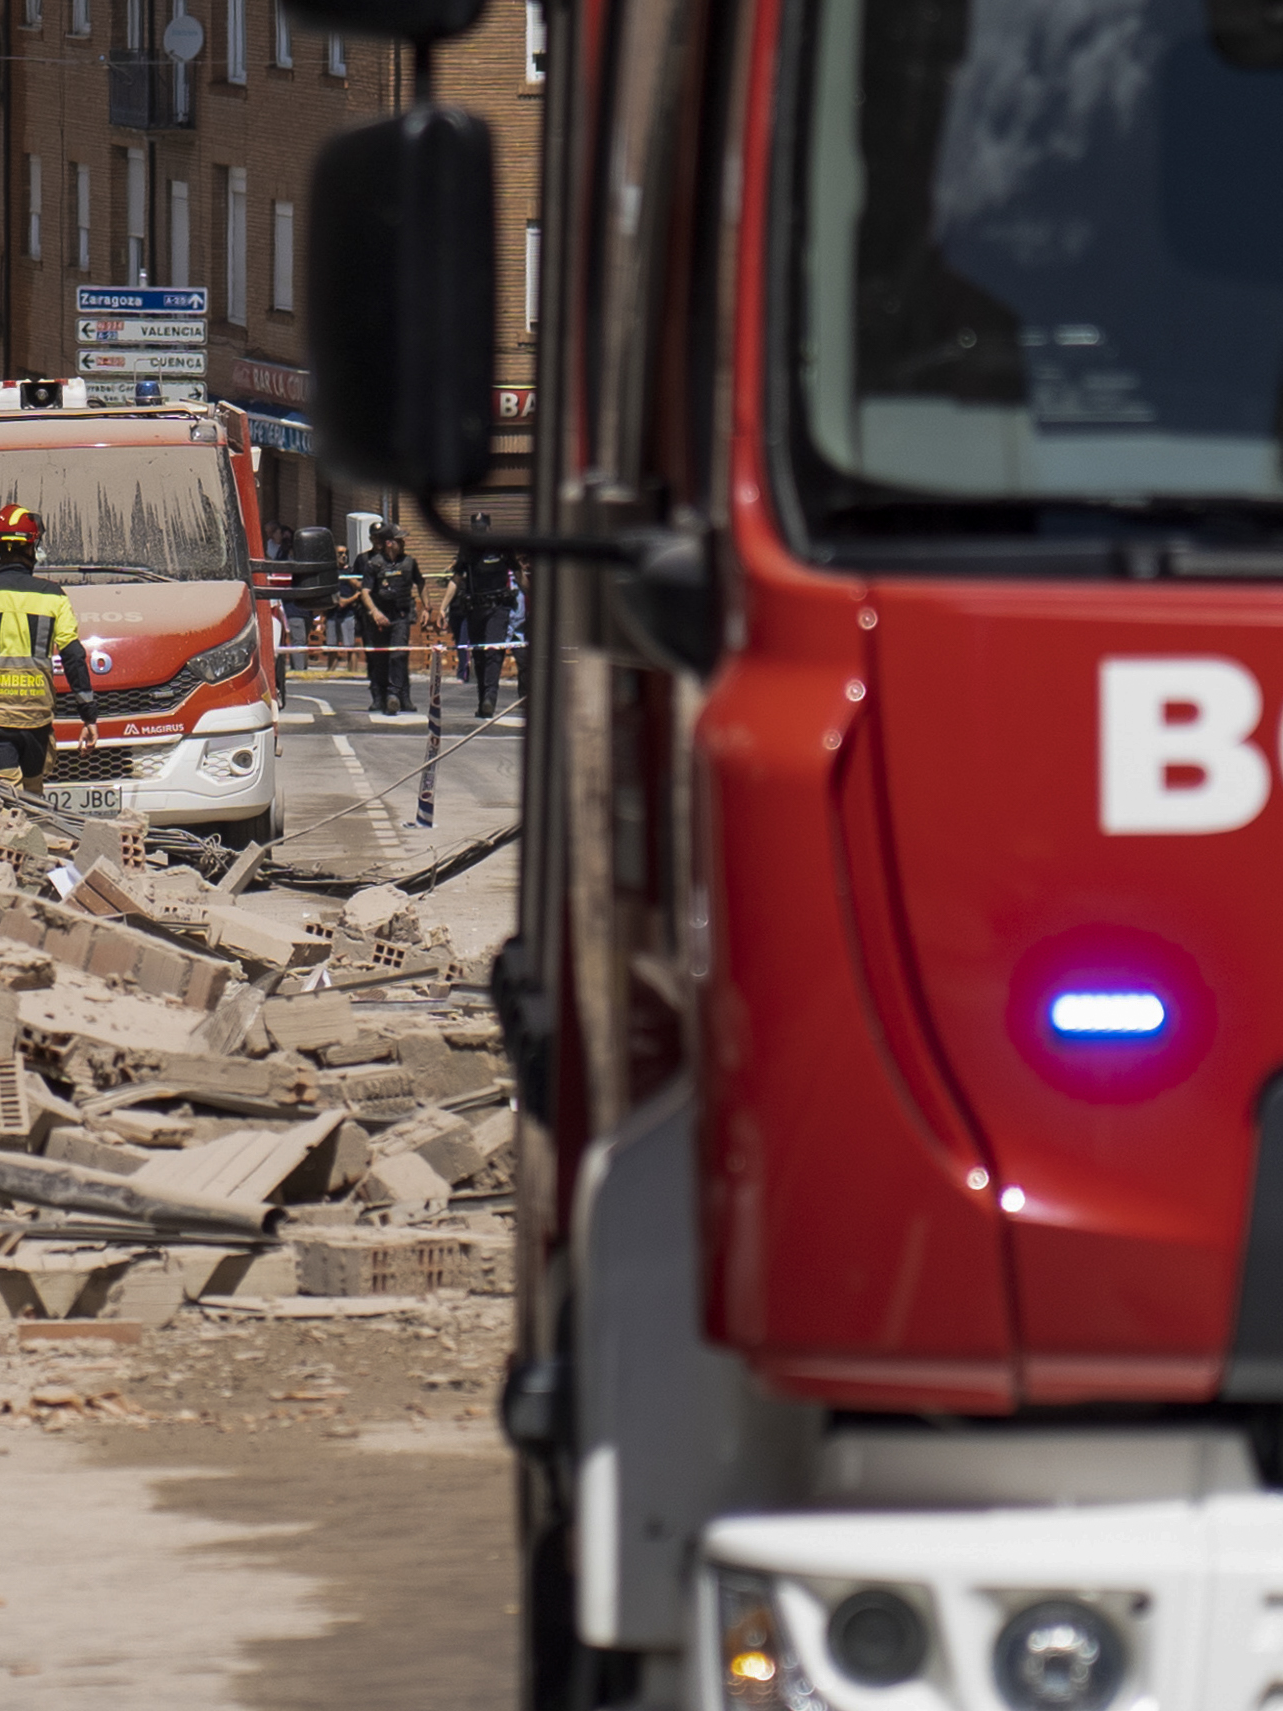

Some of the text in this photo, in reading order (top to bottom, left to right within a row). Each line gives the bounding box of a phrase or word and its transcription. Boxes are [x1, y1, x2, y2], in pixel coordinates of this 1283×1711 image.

[81, 292, 143, 308] Zaragoza
[141, 326, 203, 337] VALENCIA
[150, 357, 202, 368] CUENCA
[86, 384, 115, 392] rrabal
[79, 611, 144, 622] ROS
[141, 723, 184, 734] MAGIRUS
[1098, 653, 1283, 836] B
[79, 790, 116, 808] JBC
